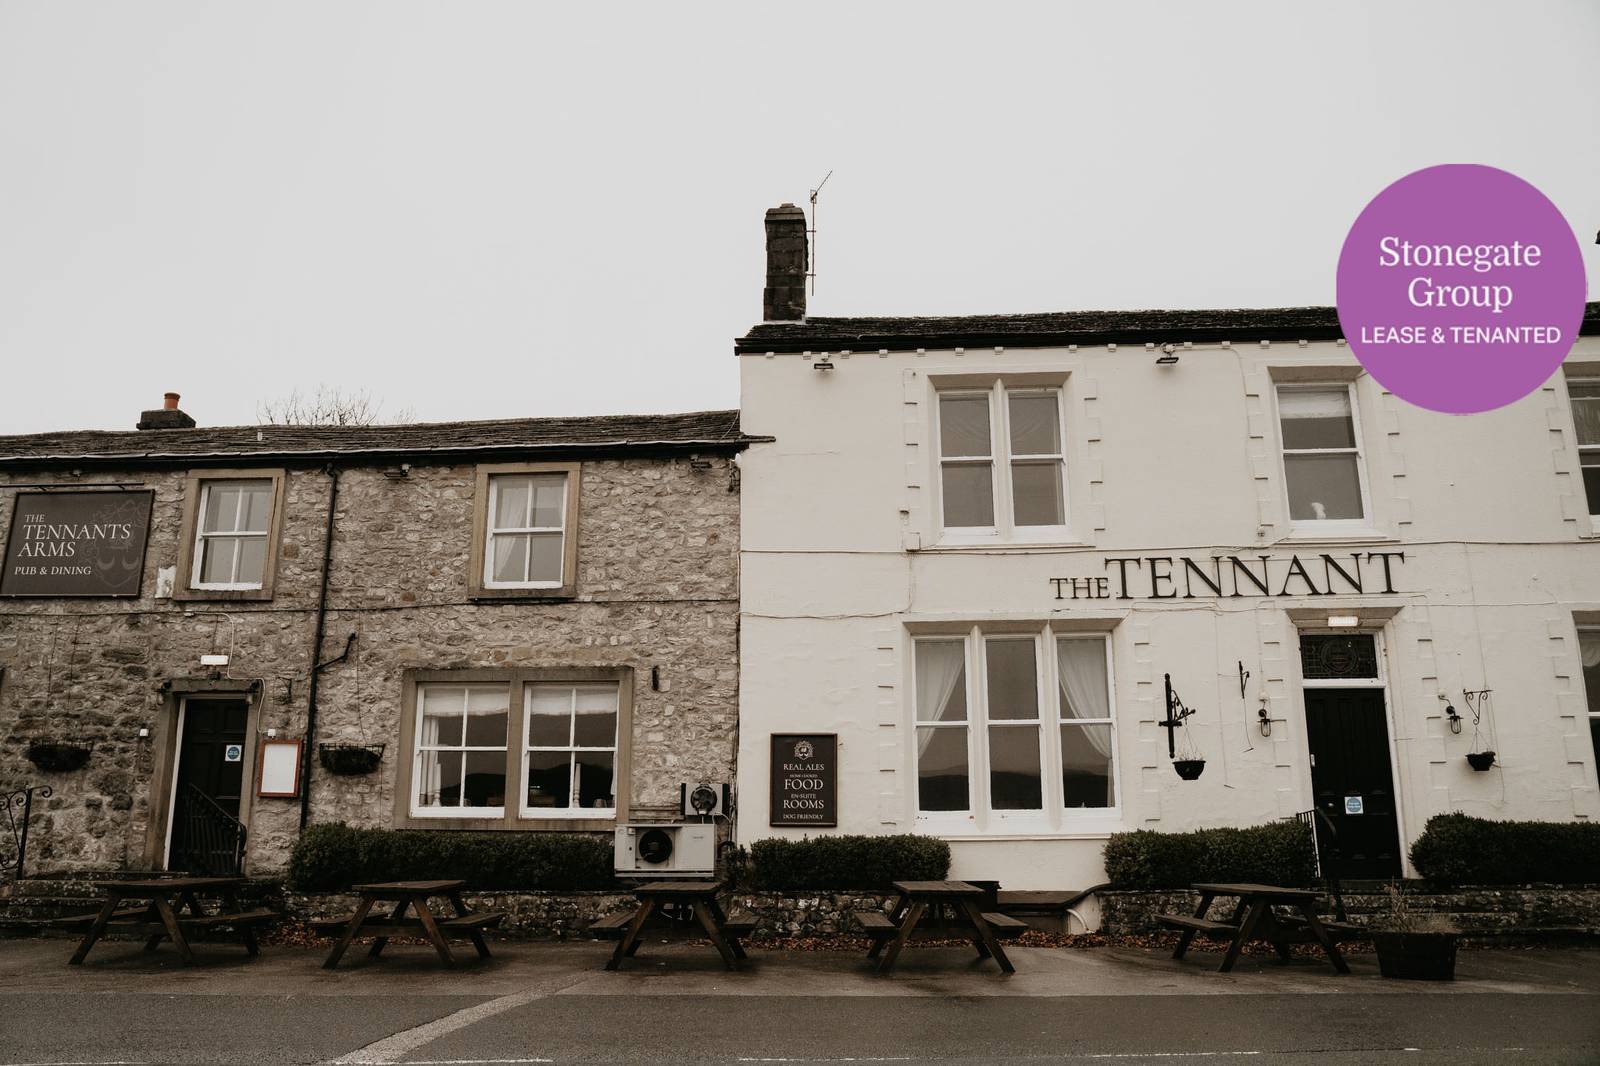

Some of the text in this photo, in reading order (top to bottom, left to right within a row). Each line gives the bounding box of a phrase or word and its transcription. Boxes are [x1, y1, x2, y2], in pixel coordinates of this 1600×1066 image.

[24, 514, 45, 522] THE
[23, 523, 132, 540] TENNANTS
[17, 541, 76, 557] ARMS
[14, 566, 92, 575] PUB & DINING
[1050, 551, 1405, 600] THE TENNANT
[784, 778, 824, 790] FOOD
[783, 800, 825, 809] ROOMS
